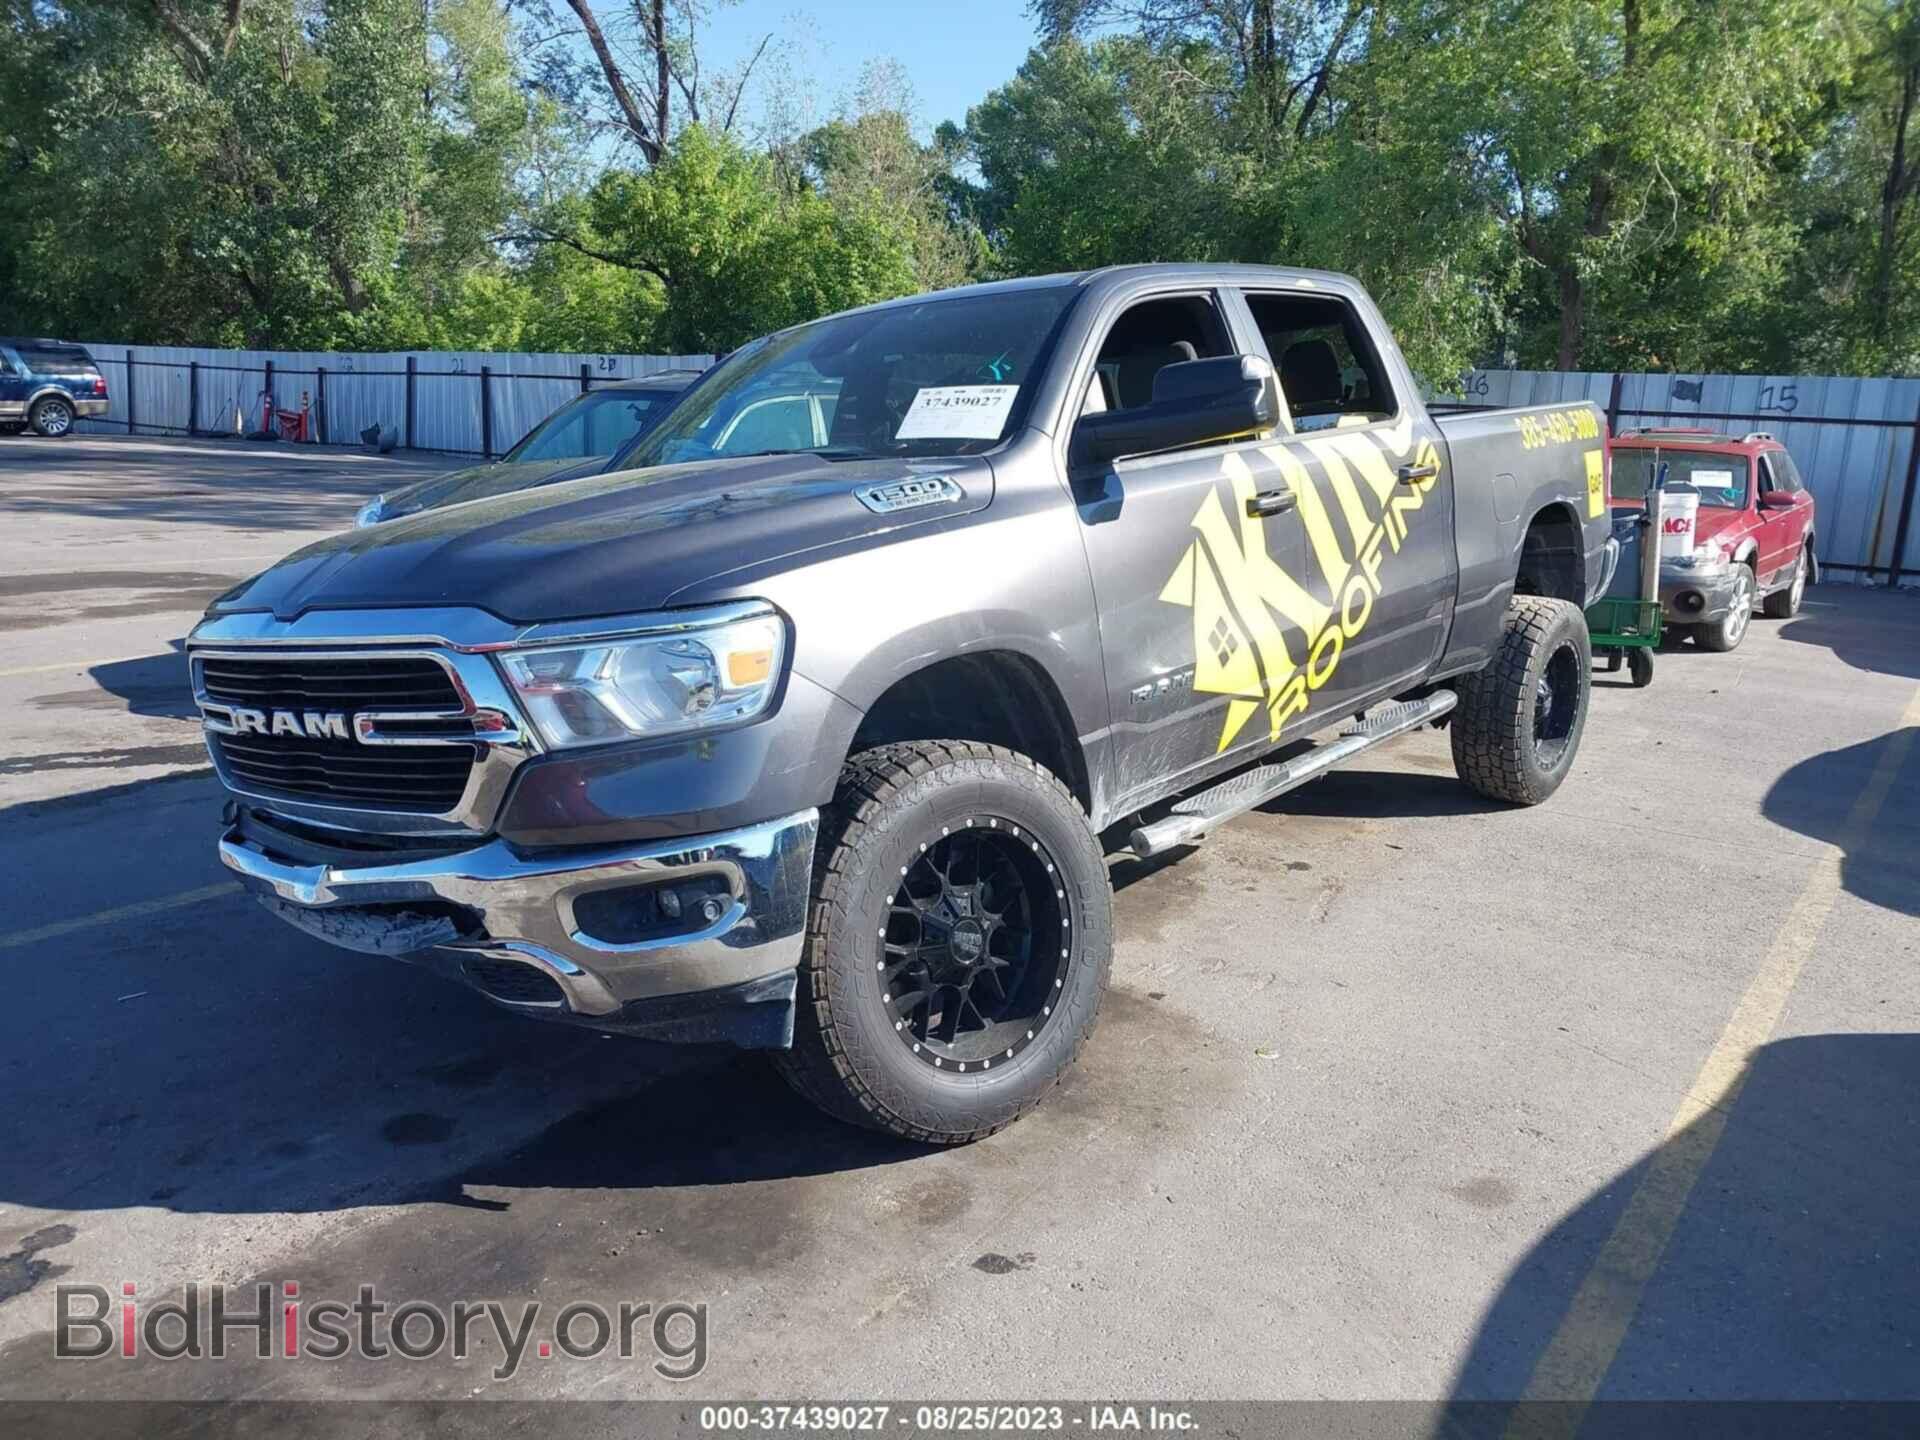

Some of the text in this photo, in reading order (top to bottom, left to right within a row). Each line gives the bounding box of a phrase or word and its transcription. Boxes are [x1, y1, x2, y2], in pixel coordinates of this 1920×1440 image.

[920, 396, 1002, 408] 37439027
[1758, 384, 1799, 412] 15
[868, 479, 942, 502] 1500
[1267, 436, 1442, 744] ROOFING
[234, 709, 349, 738] RAM
